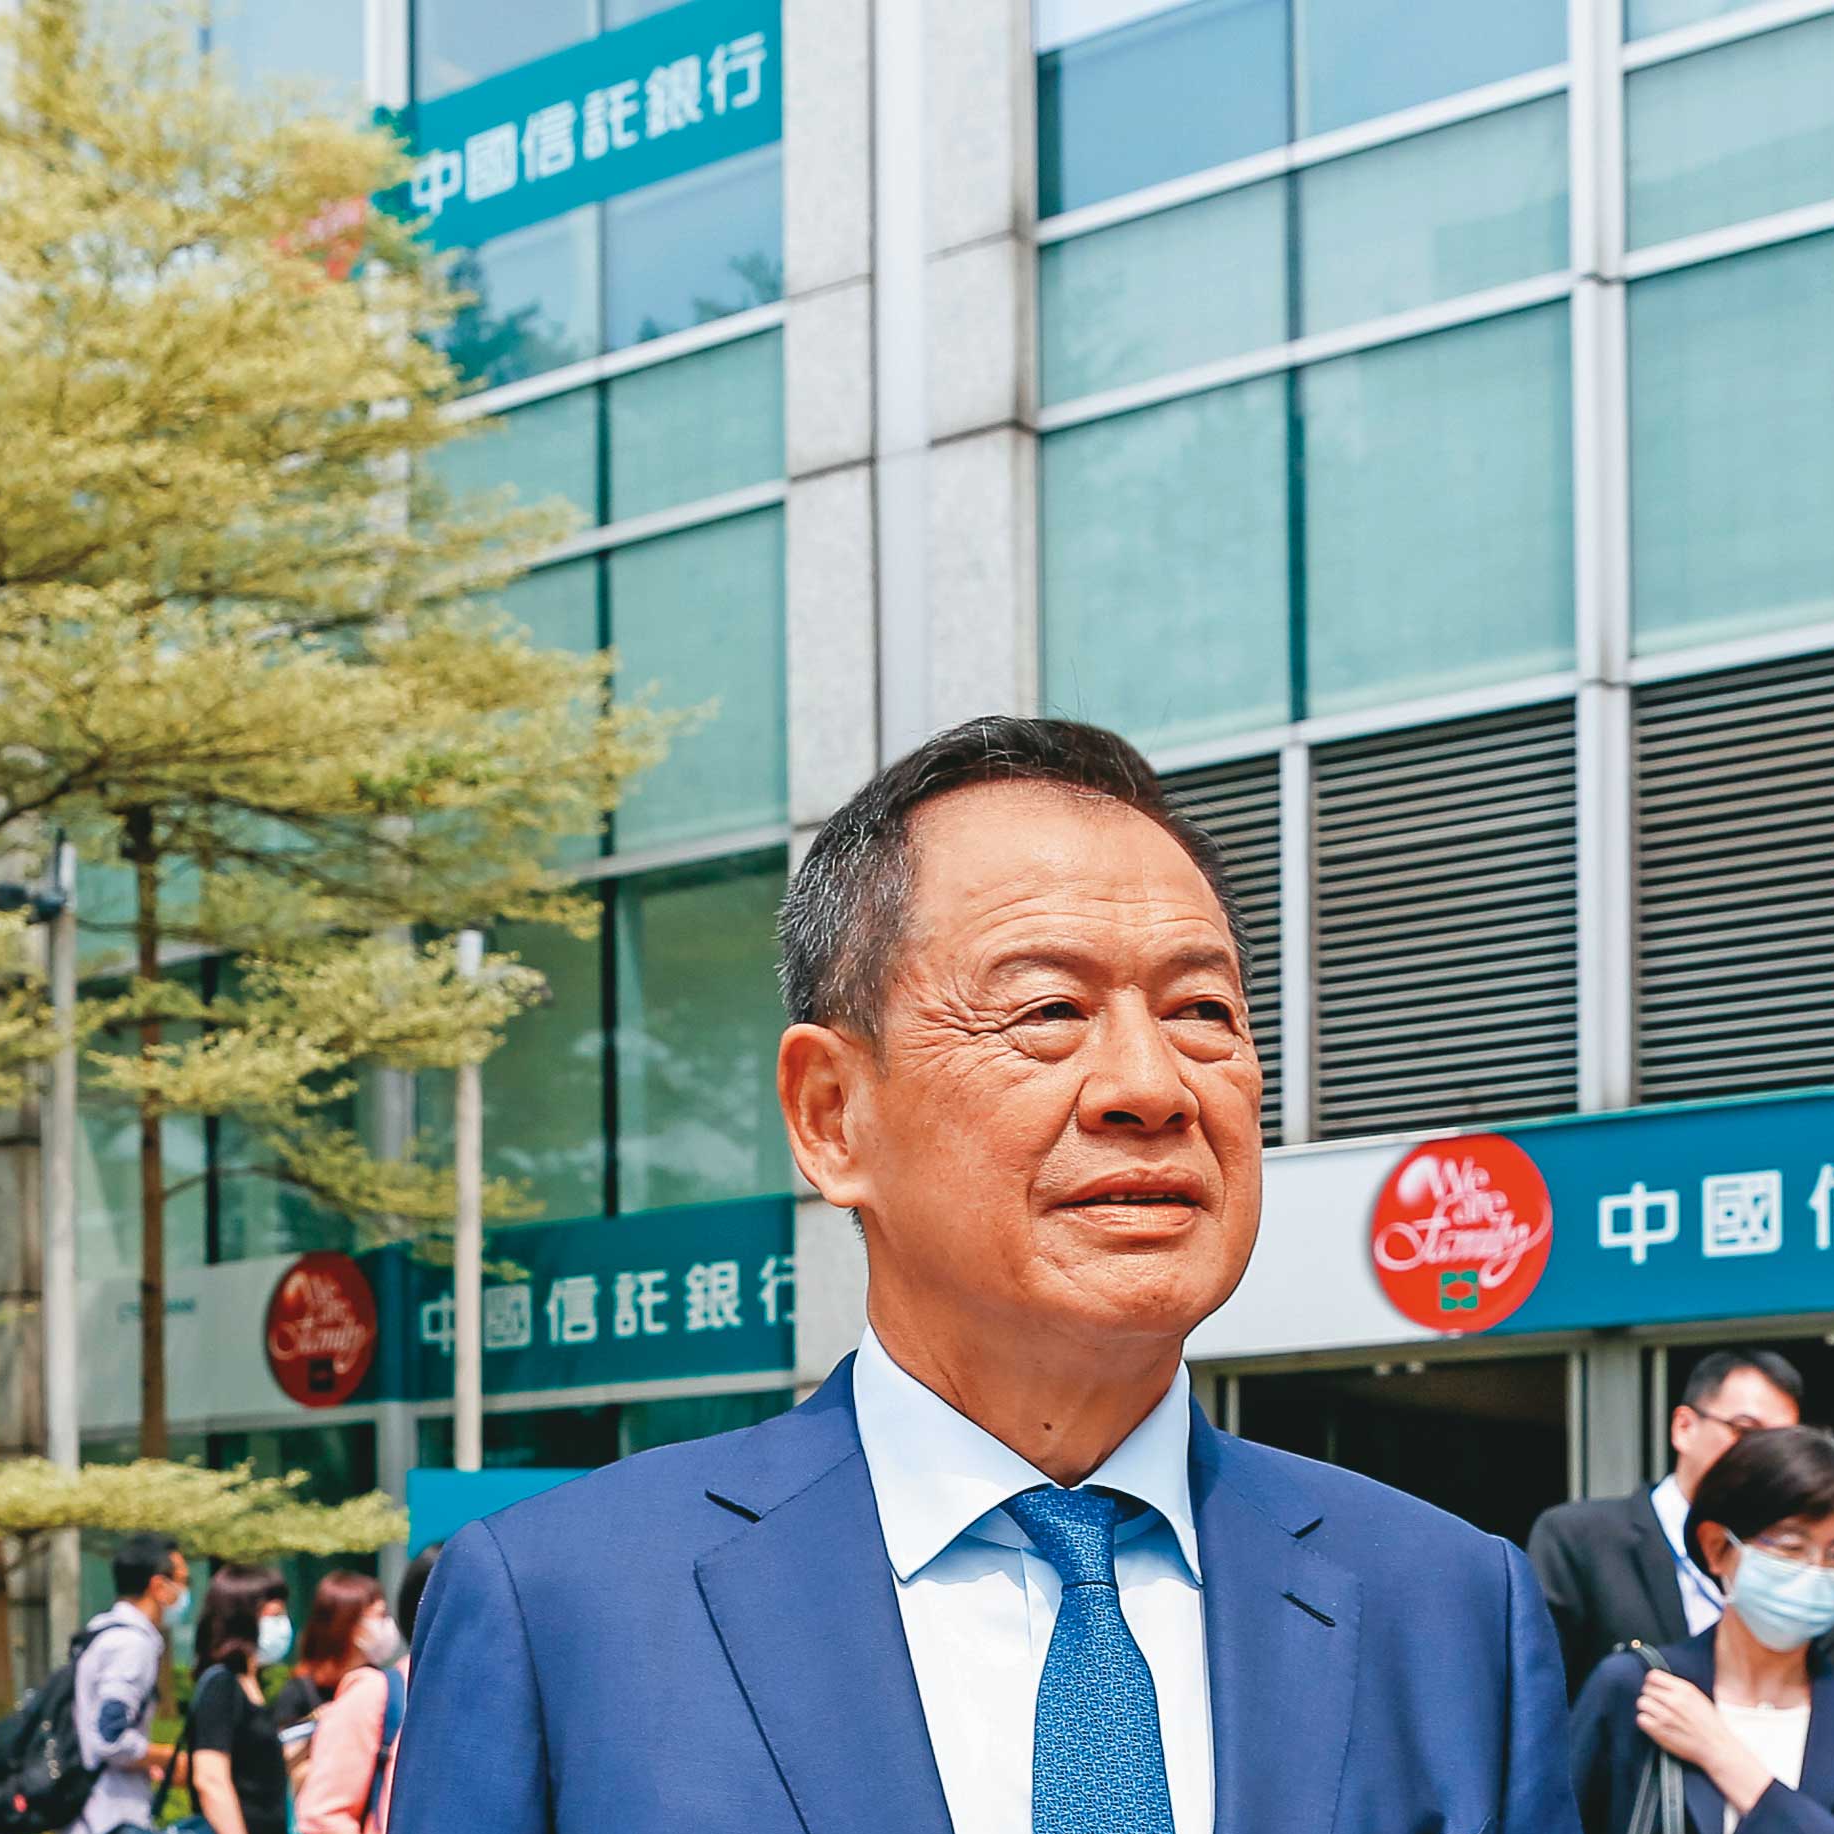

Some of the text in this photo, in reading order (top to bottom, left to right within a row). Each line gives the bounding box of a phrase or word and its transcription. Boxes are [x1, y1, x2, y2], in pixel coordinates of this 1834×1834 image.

[410, 31, 768, 217] 中國信託銀行
